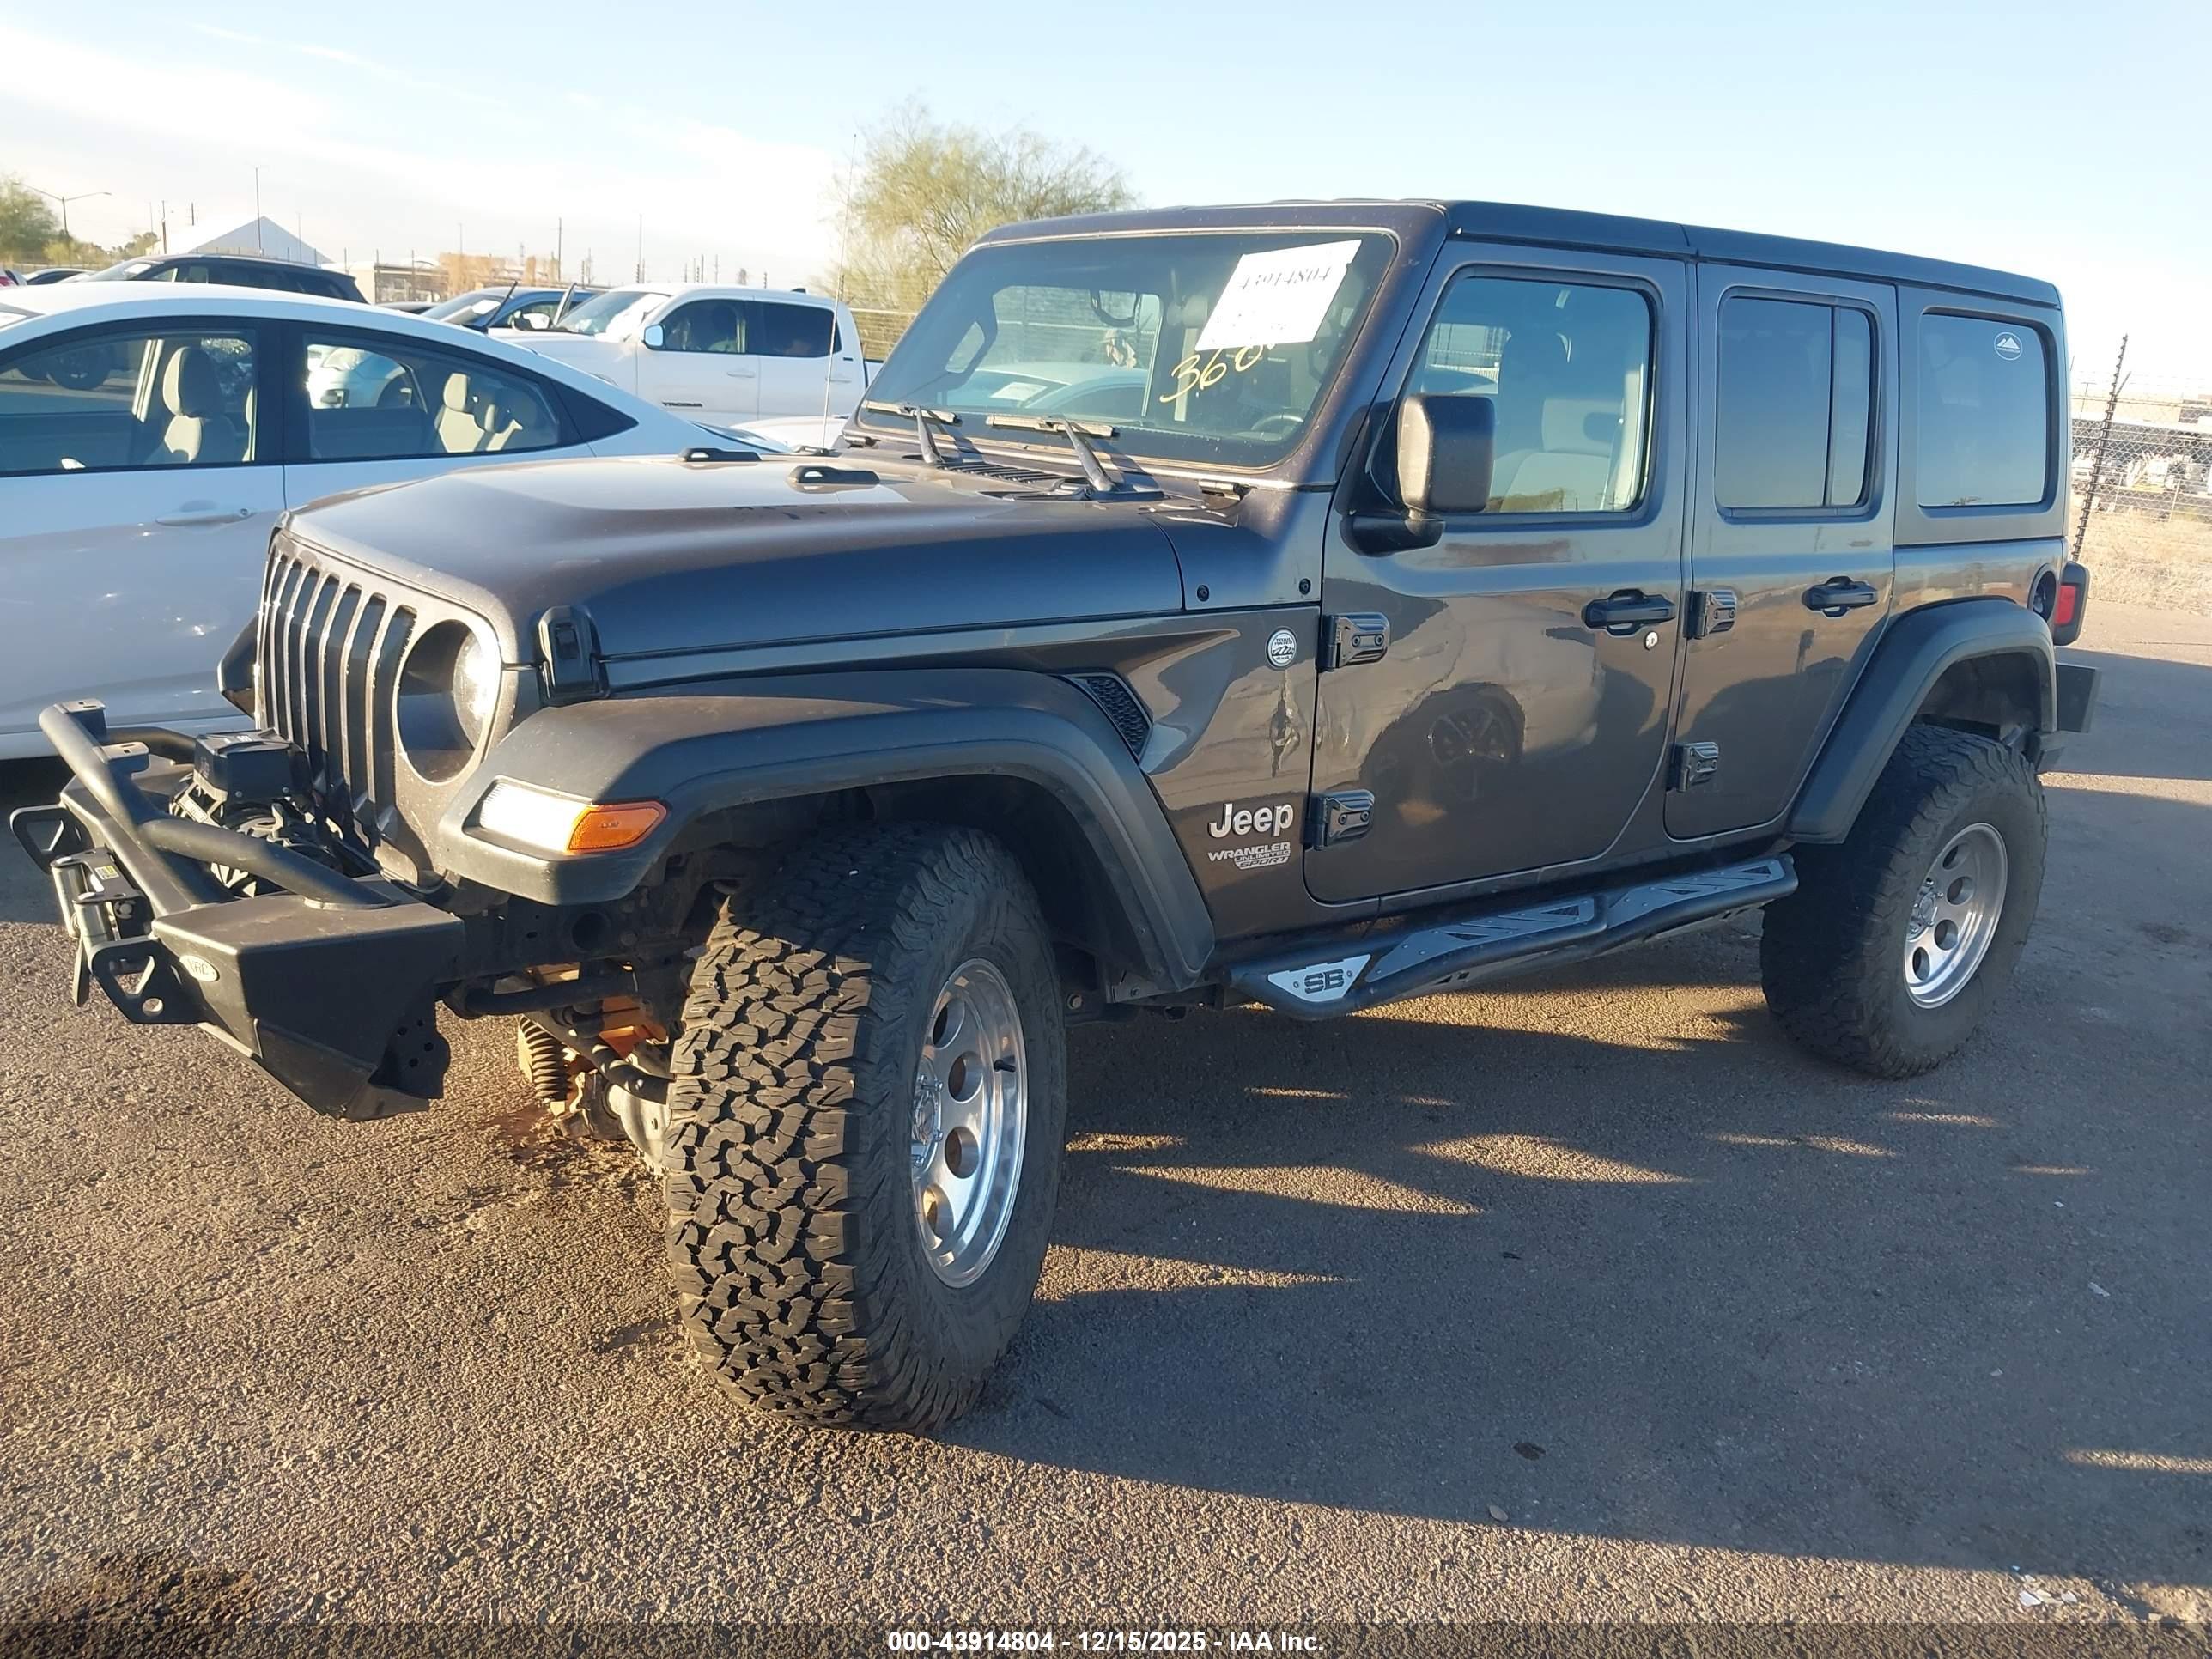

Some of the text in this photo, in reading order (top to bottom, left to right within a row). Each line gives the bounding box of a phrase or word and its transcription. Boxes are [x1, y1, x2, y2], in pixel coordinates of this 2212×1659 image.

[1207, 803, 1294, 838] Jeep
[1208, 842, 1291, 862] WRANGLER
[1304, 969, 1345, 994] SB
